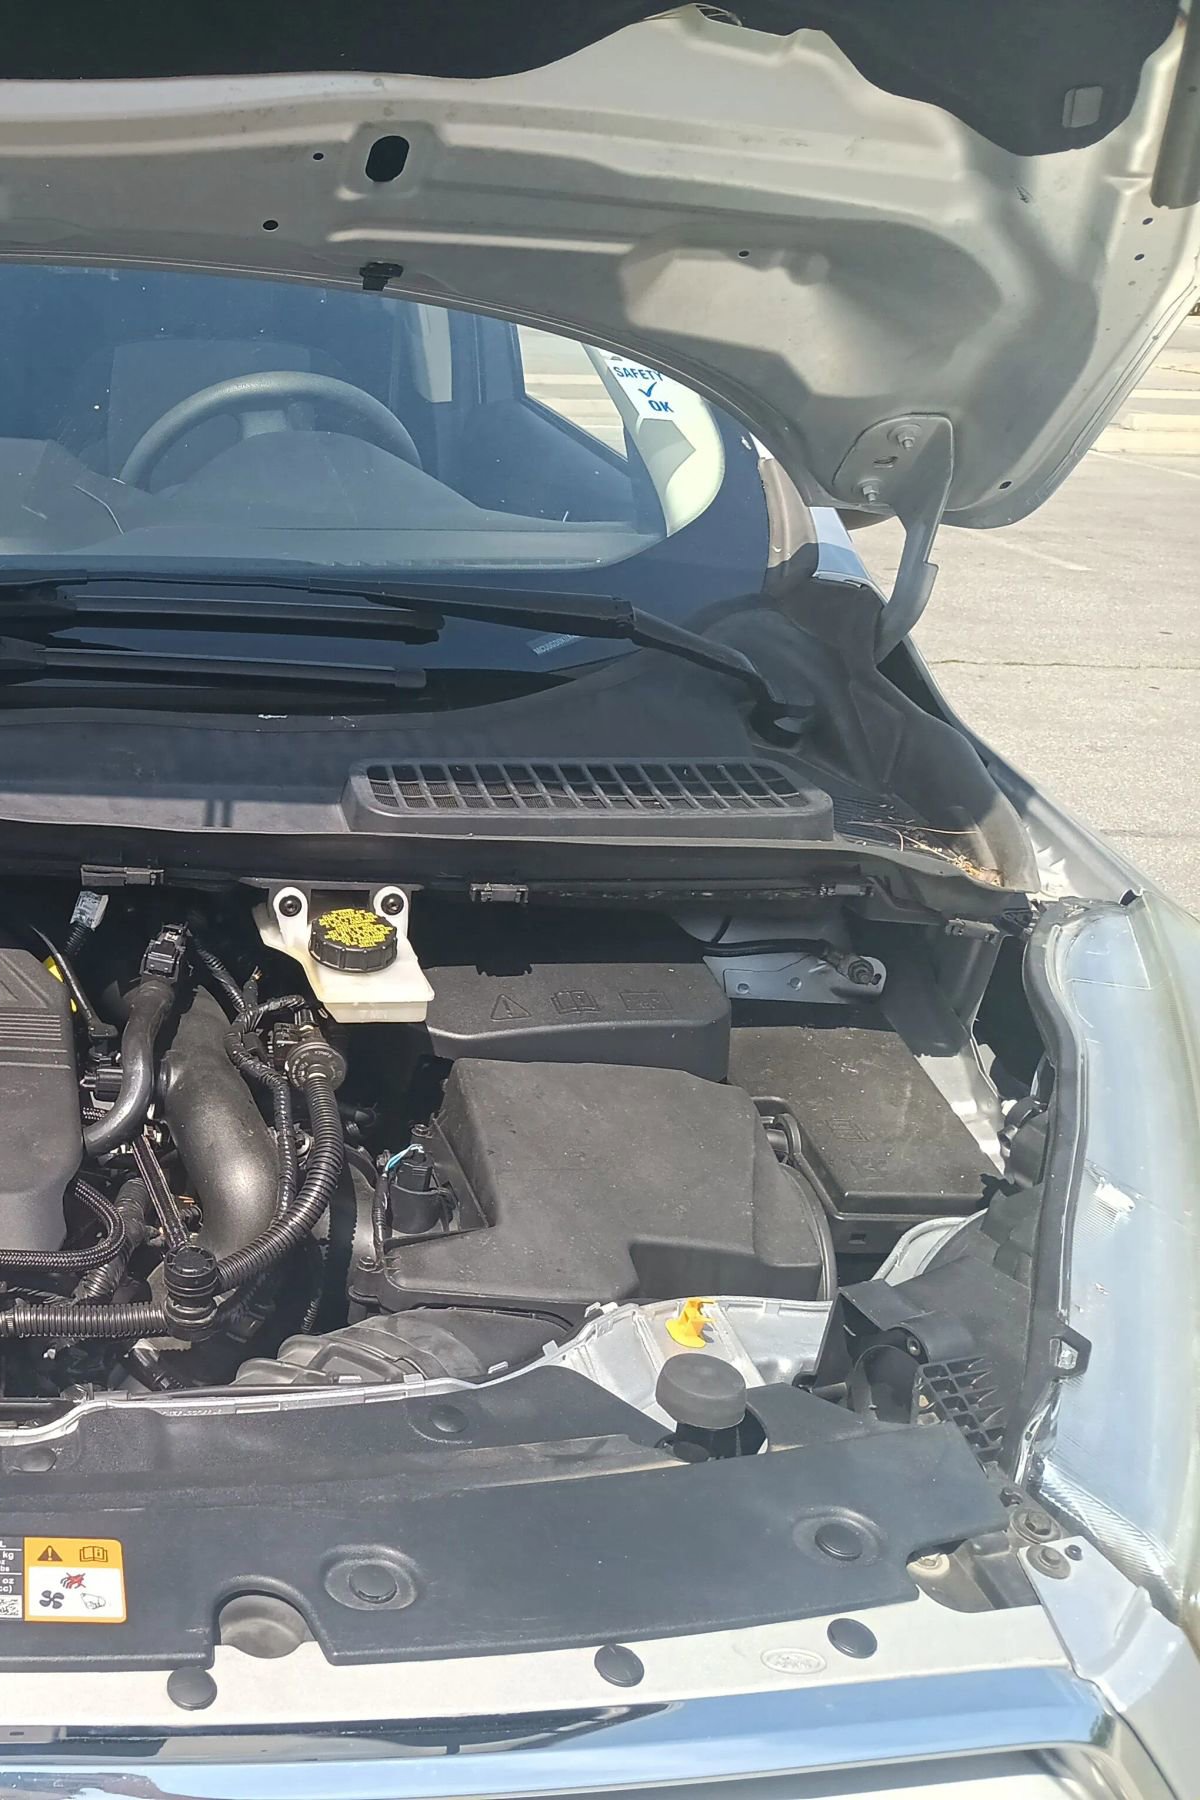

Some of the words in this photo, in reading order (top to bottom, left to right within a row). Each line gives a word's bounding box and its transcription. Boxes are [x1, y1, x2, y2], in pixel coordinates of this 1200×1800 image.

[613, 366, 663, 381] SAFETY
[648, 400, 674, 412] OK
[3, 1551, 15, 1560] kg
